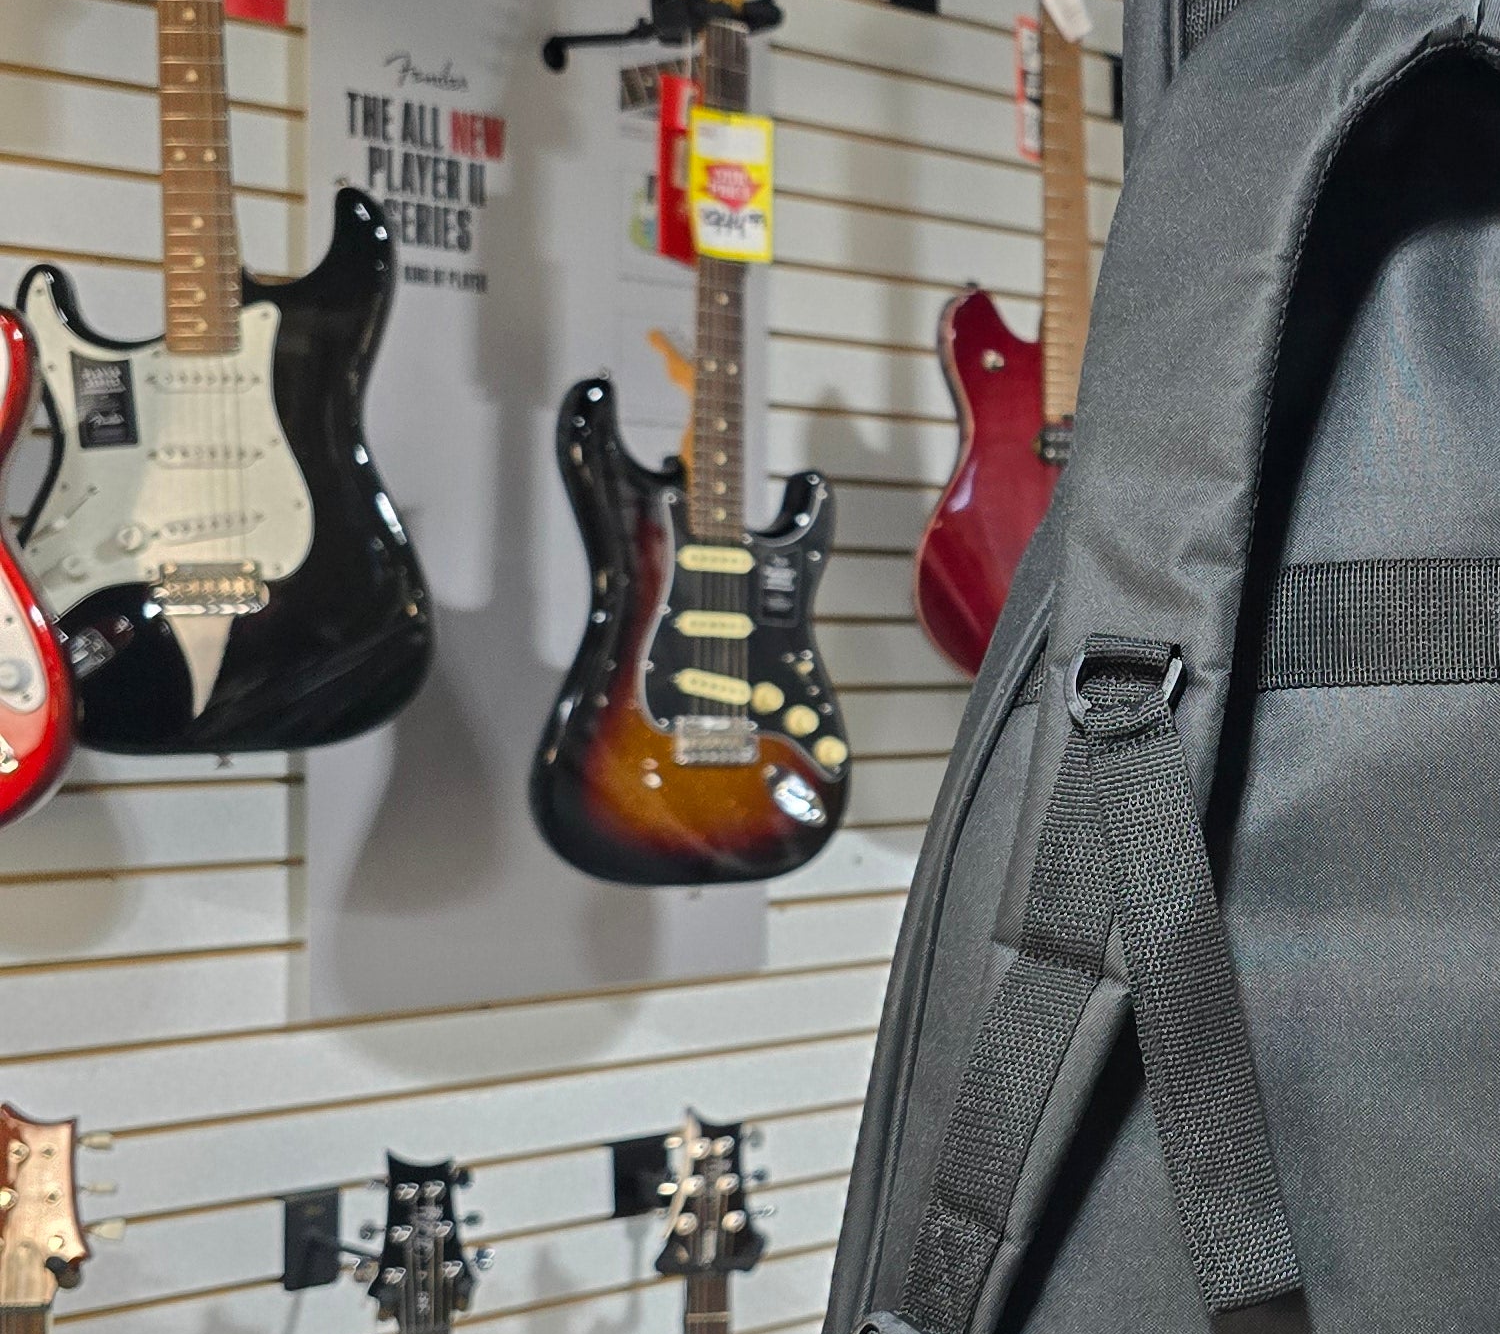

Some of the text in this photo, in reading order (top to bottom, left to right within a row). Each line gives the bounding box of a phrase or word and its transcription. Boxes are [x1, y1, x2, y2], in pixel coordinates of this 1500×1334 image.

[347, 91, 506, 161] THE ALL NEW
[368, 146, 461, 199] PLAYER
